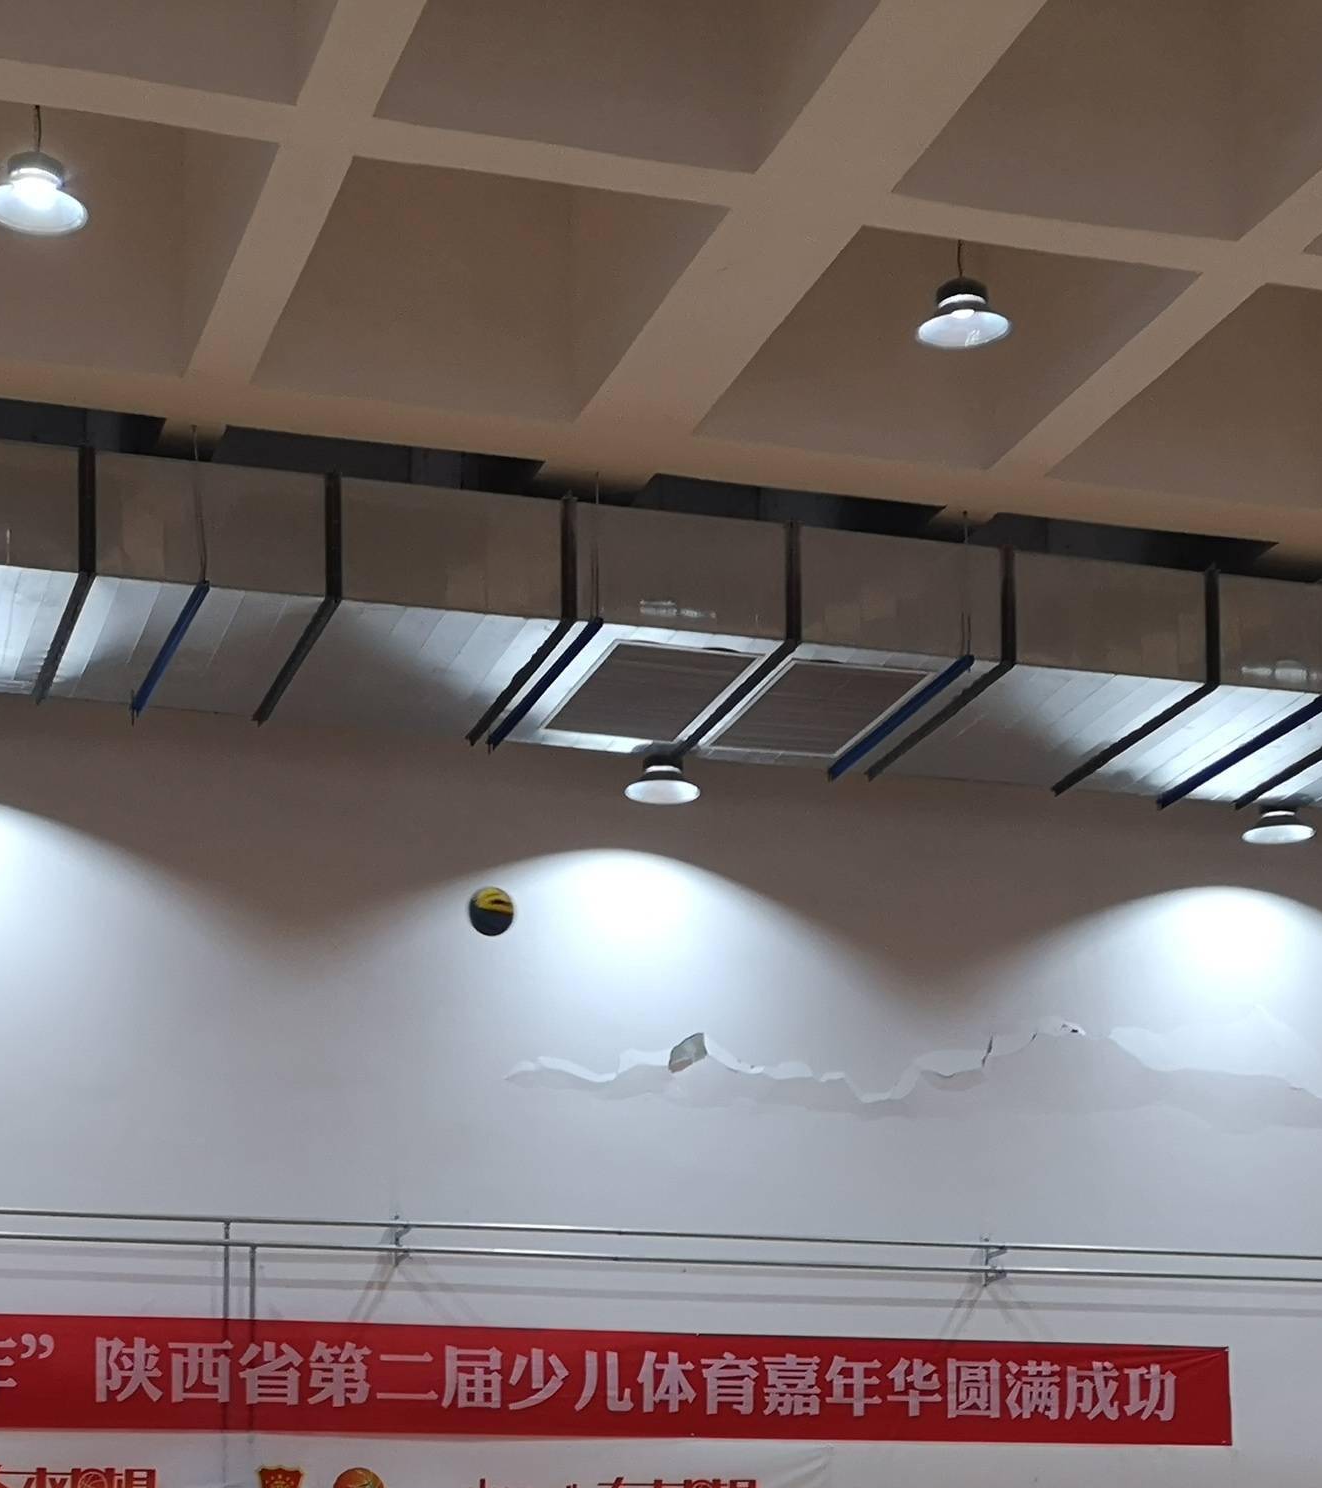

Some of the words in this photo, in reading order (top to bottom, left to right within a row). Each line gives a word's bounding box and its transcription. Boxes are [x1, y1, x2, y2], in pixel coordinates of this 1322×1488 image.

[96, 1336, 1177, 1421] 陕西省第二届少儿体育嘉年华圆满成功
